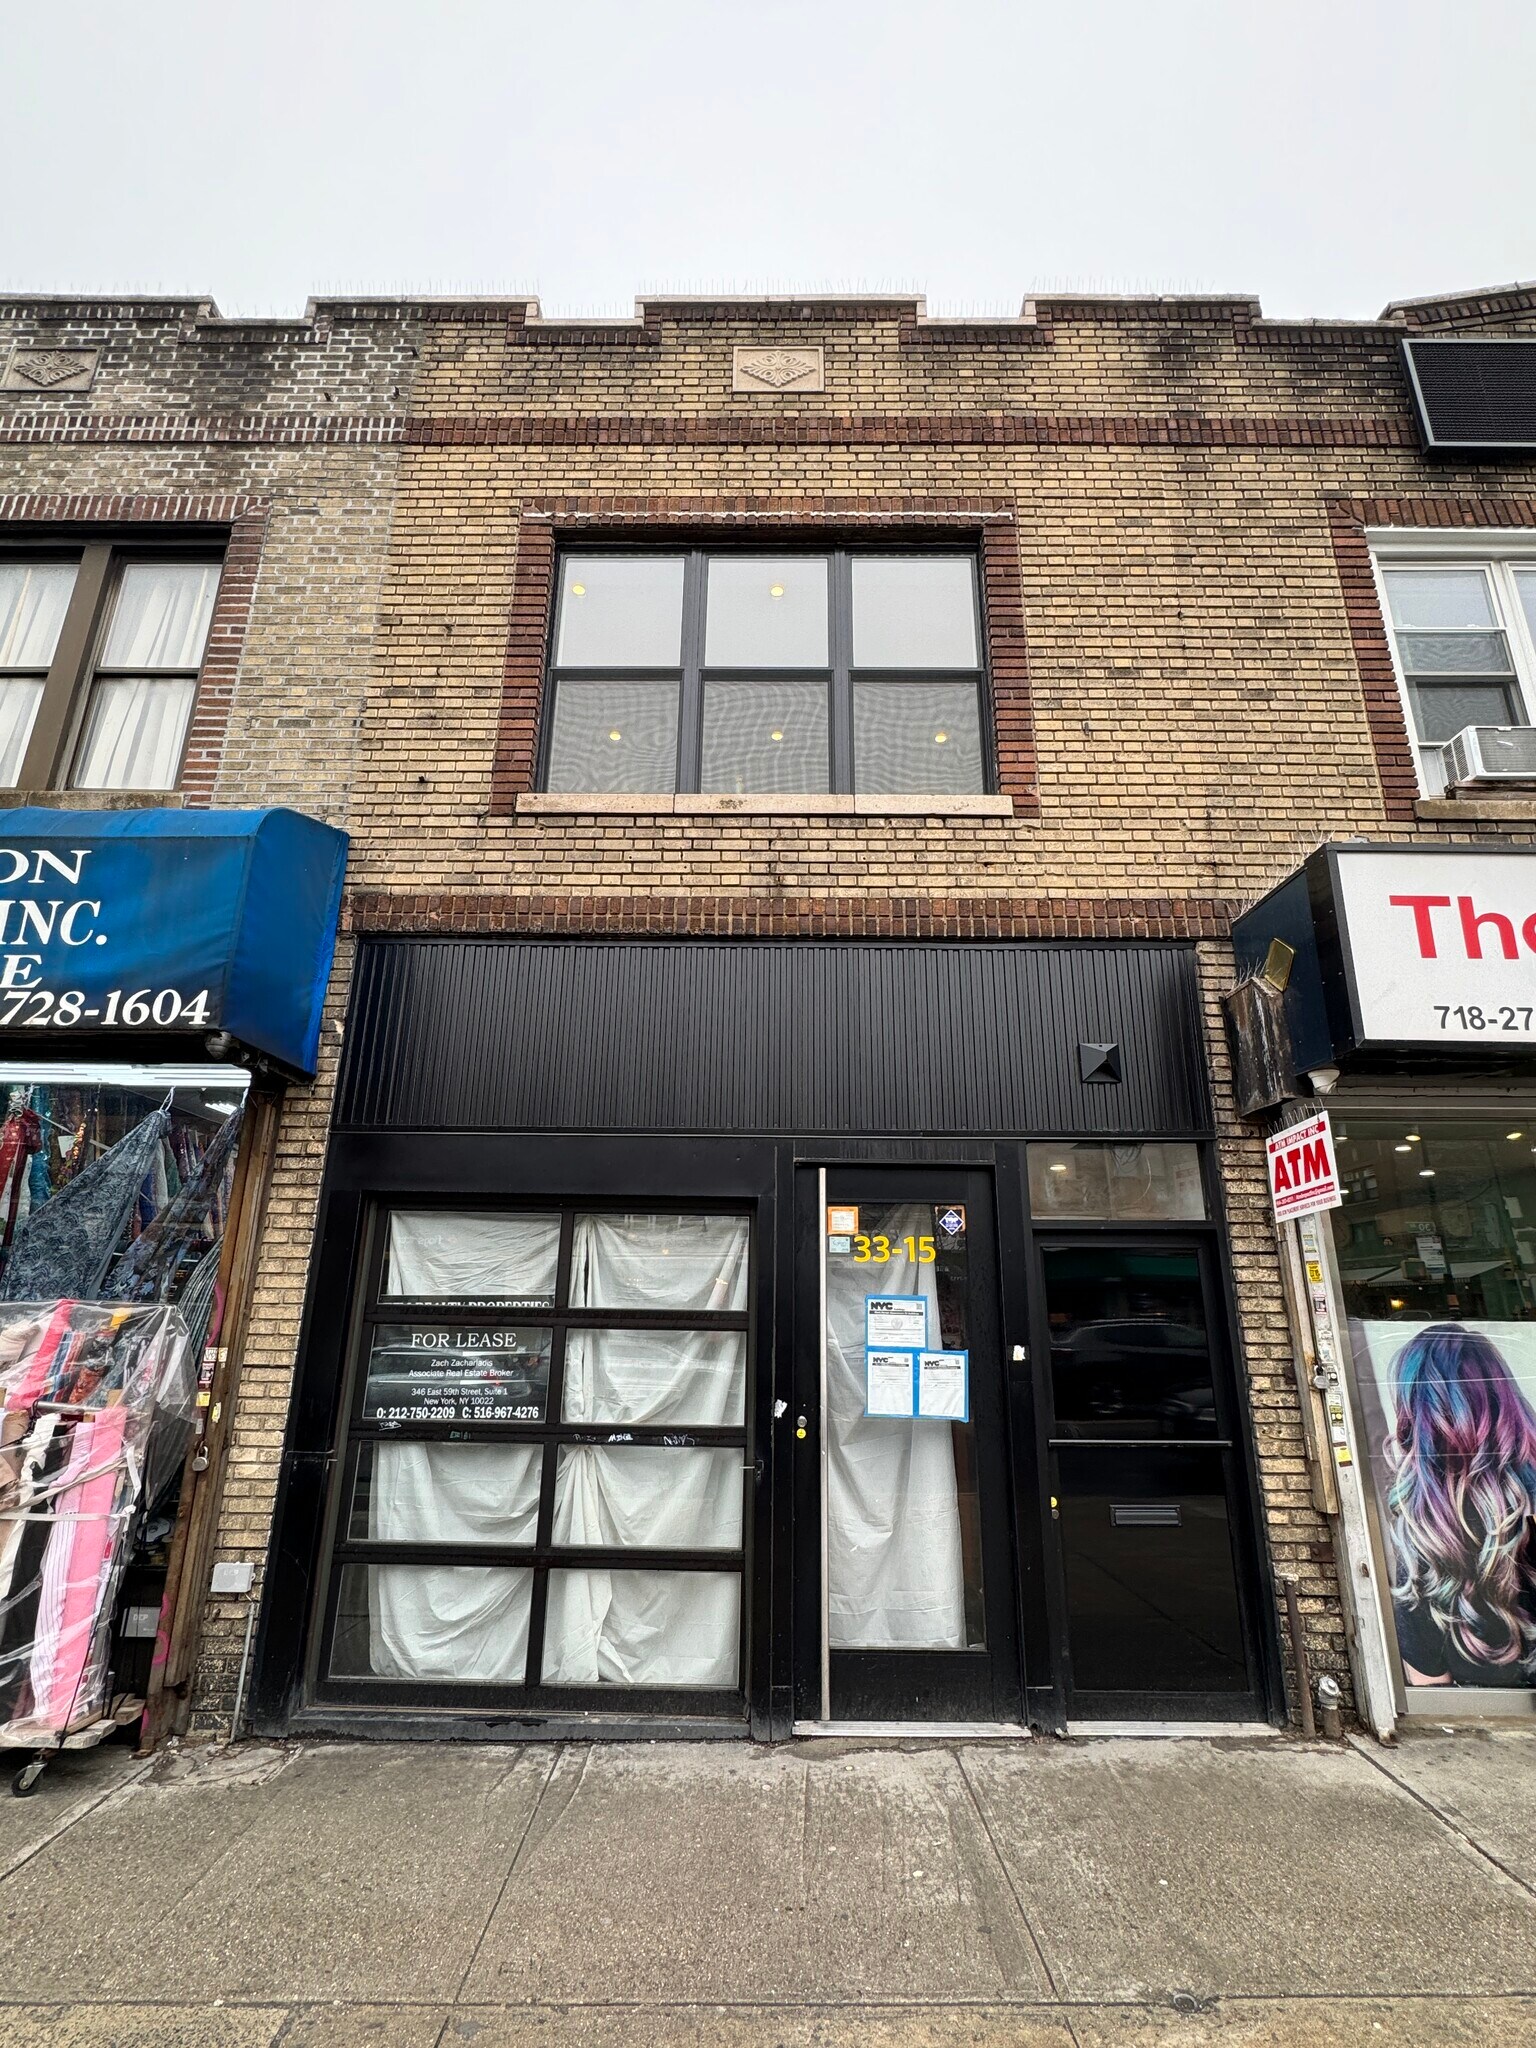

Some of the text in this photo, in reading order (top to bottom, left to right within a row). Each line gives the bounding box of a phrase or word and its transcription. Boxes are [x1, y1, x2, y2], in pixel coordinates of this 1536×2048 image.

[0, 900, 107, 945] INC.
[1389, 895, 1536, 959] Th
[0, 954, 43, 988] E
[0, 989, 210, 1026] 728-1604
[1433, 1006, 1533, 1030] 718-27
[1274, 1124, 1320, 1151] ATM IMPACT INC
[1275, 1138, 1331, 1194] ATM
[853, 1235, 936, 1263] 33-15
[870, 1302, 893, 1310] NYC
[410, 1333, 517, 1348] FOR LEASE
[408, 1369, 514, 1378] Associate Real Estate Broker
[430, 1359, 449, 1367] Zach
[411, 1388, 426, 1396] 346
[427, 1388, 442, 1396] East
[443, 1388, 459, 1396] 59th
[484, 1388, 501, 1396] Suite
[503, 1388, 508, 1396] 1
[424, 1397, 438, 1405] New
[459, 1397, 469, 1405] NY
[471, 1397, 494, 1405] 10022
[388, 1407, 456, 1419] 212-750-2209
[462, 1407, 472, 1418] C:
[473, 1407, 539, 1419] 516-967-4276
